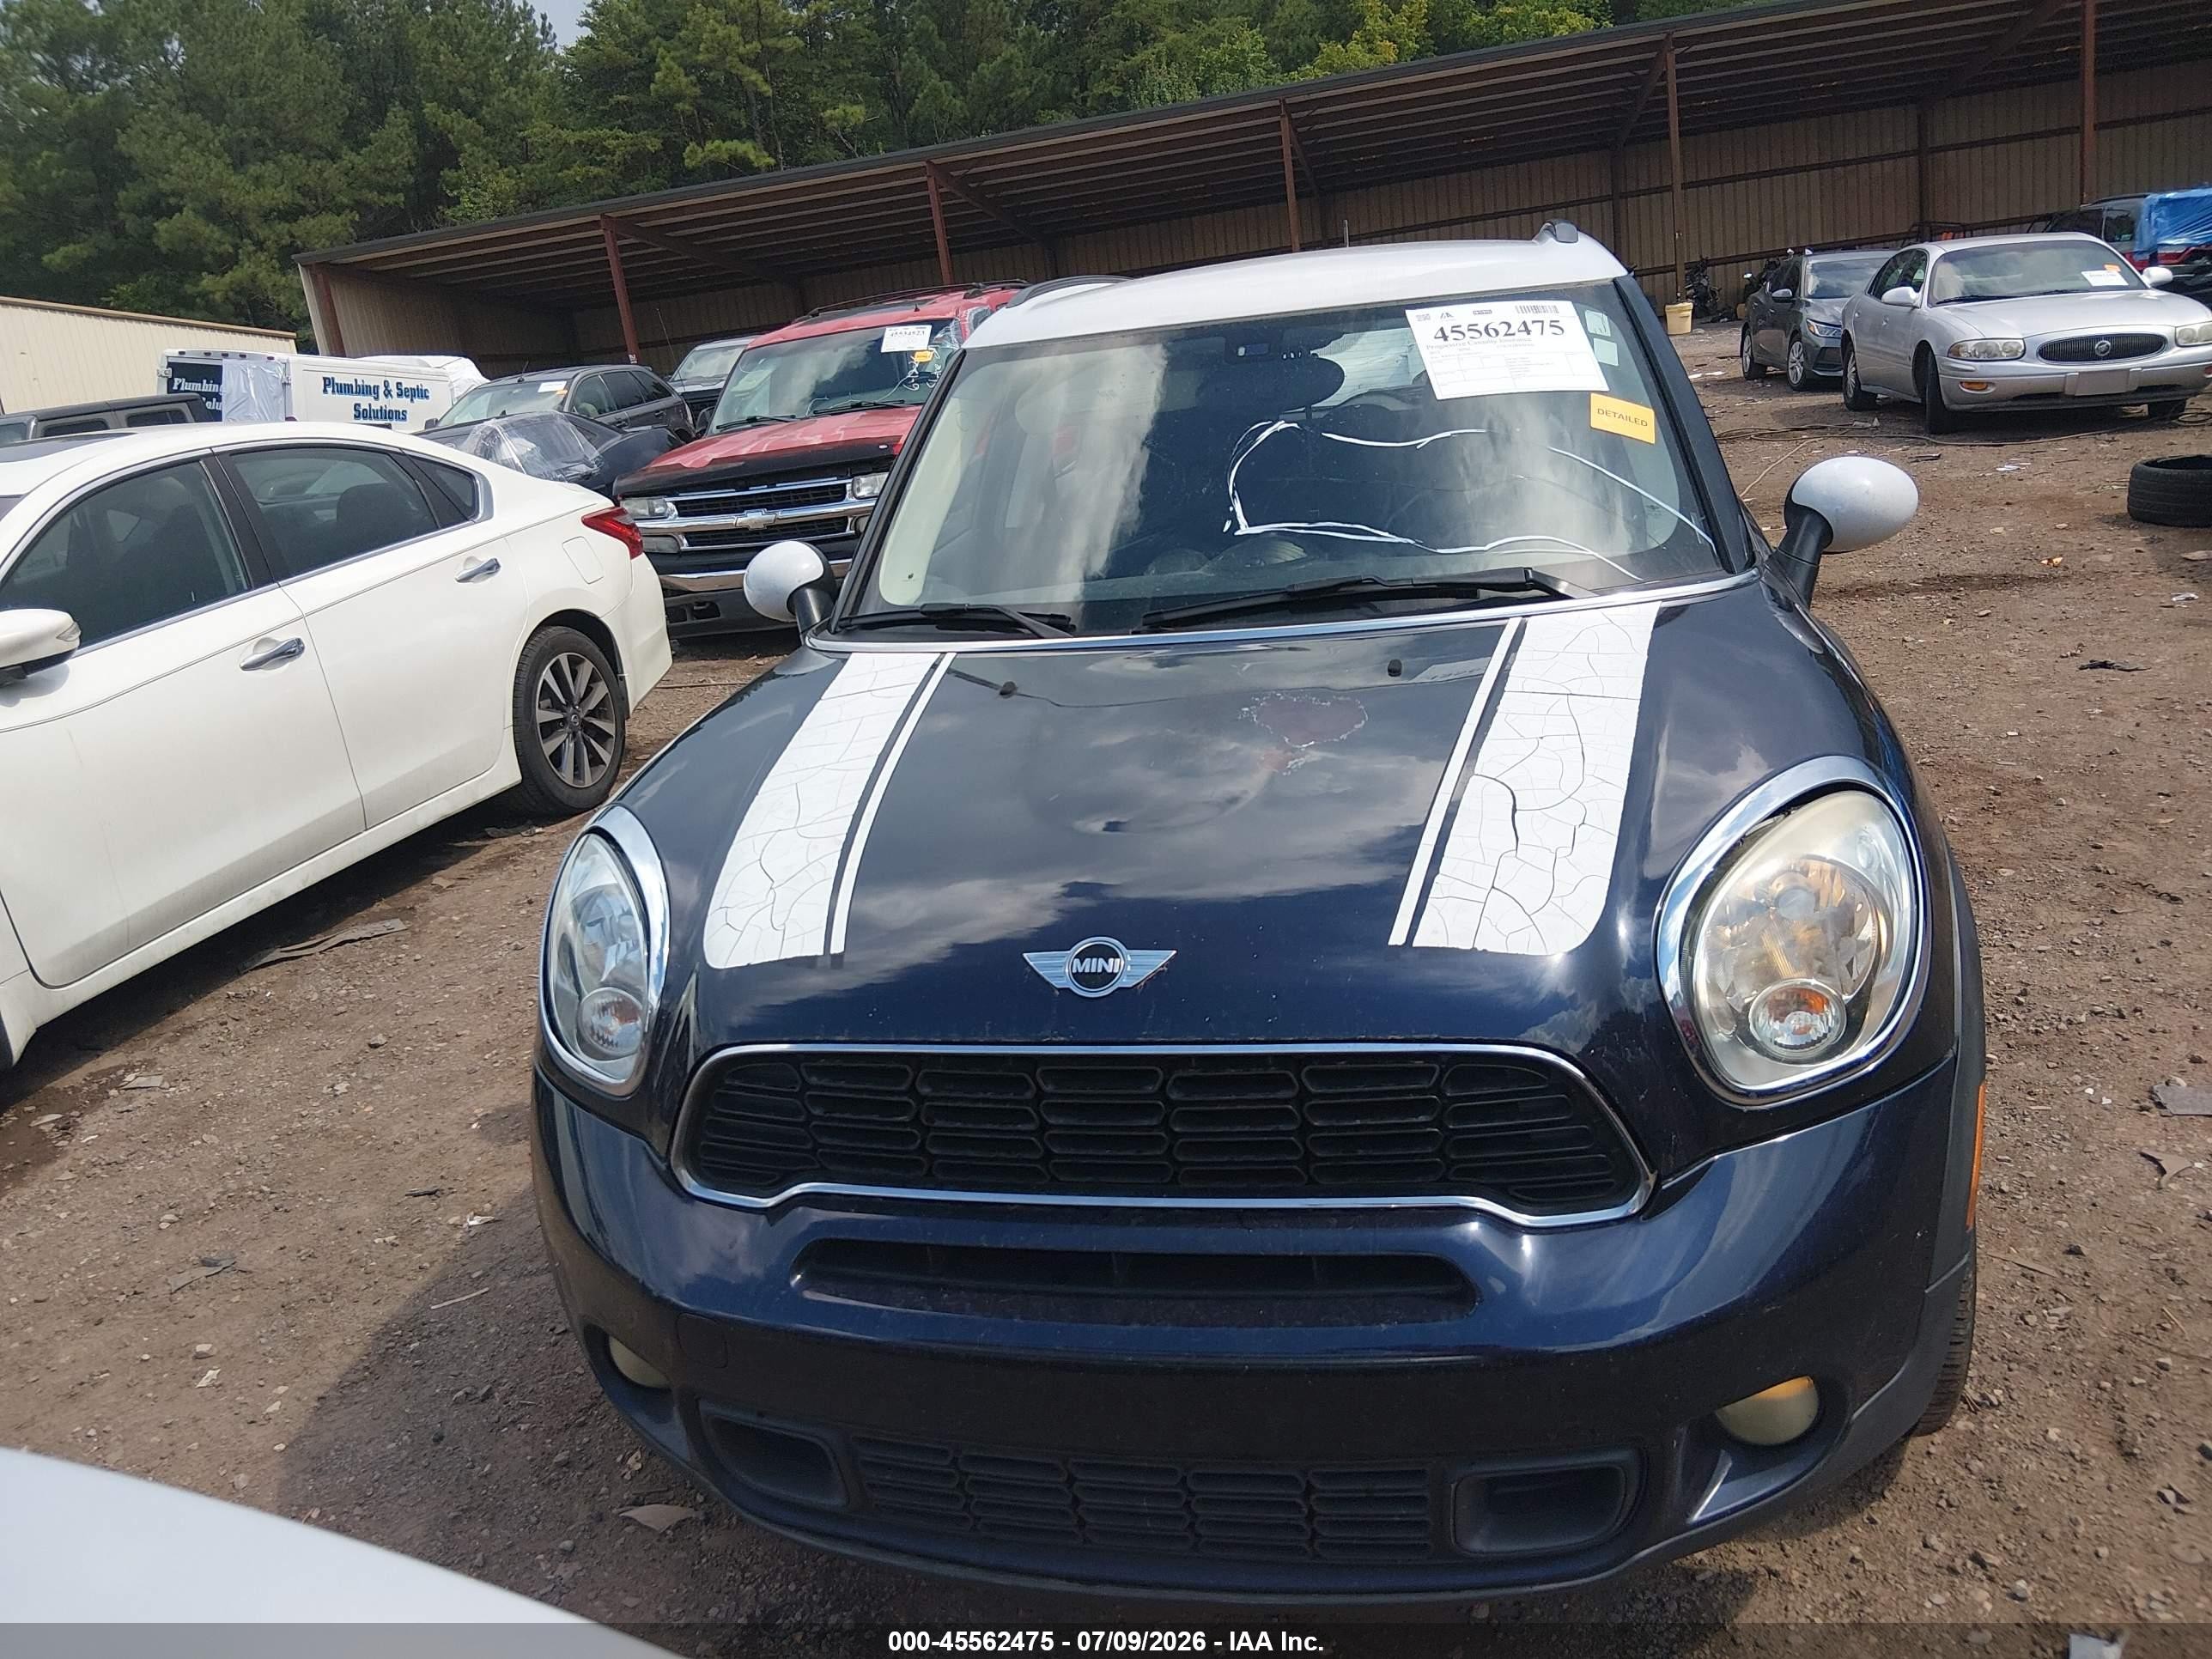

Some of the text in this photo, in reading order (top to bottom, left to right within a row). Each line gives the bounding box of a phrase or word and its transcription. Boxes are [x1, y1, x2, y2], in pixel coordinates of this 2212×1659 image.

[1433, 319, 1565, 342] 45562475
[322, 376, 430, 404] Plumbing & Septic
[353, 402, 408, 422] Solutions
[1597, 408, 1648, 427] DETAILED
[1073, 957, 1120, 973] MINI
